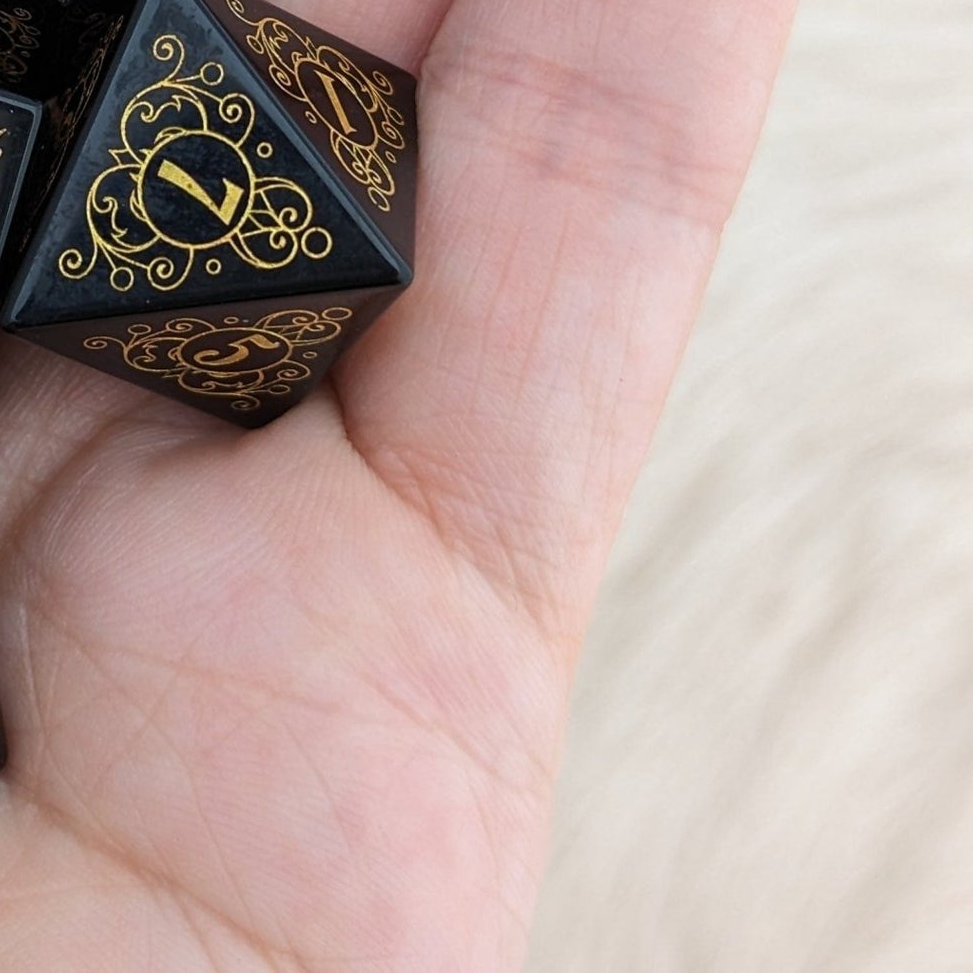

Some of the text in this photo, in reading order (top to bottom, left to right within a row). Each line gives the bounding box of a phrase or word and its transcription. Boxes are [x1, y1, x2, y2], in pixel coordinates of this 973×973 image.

[312, 68, 357, 137] 1
[157, 158, 245, 226] 7
[193, 333, 280, 365] 5
